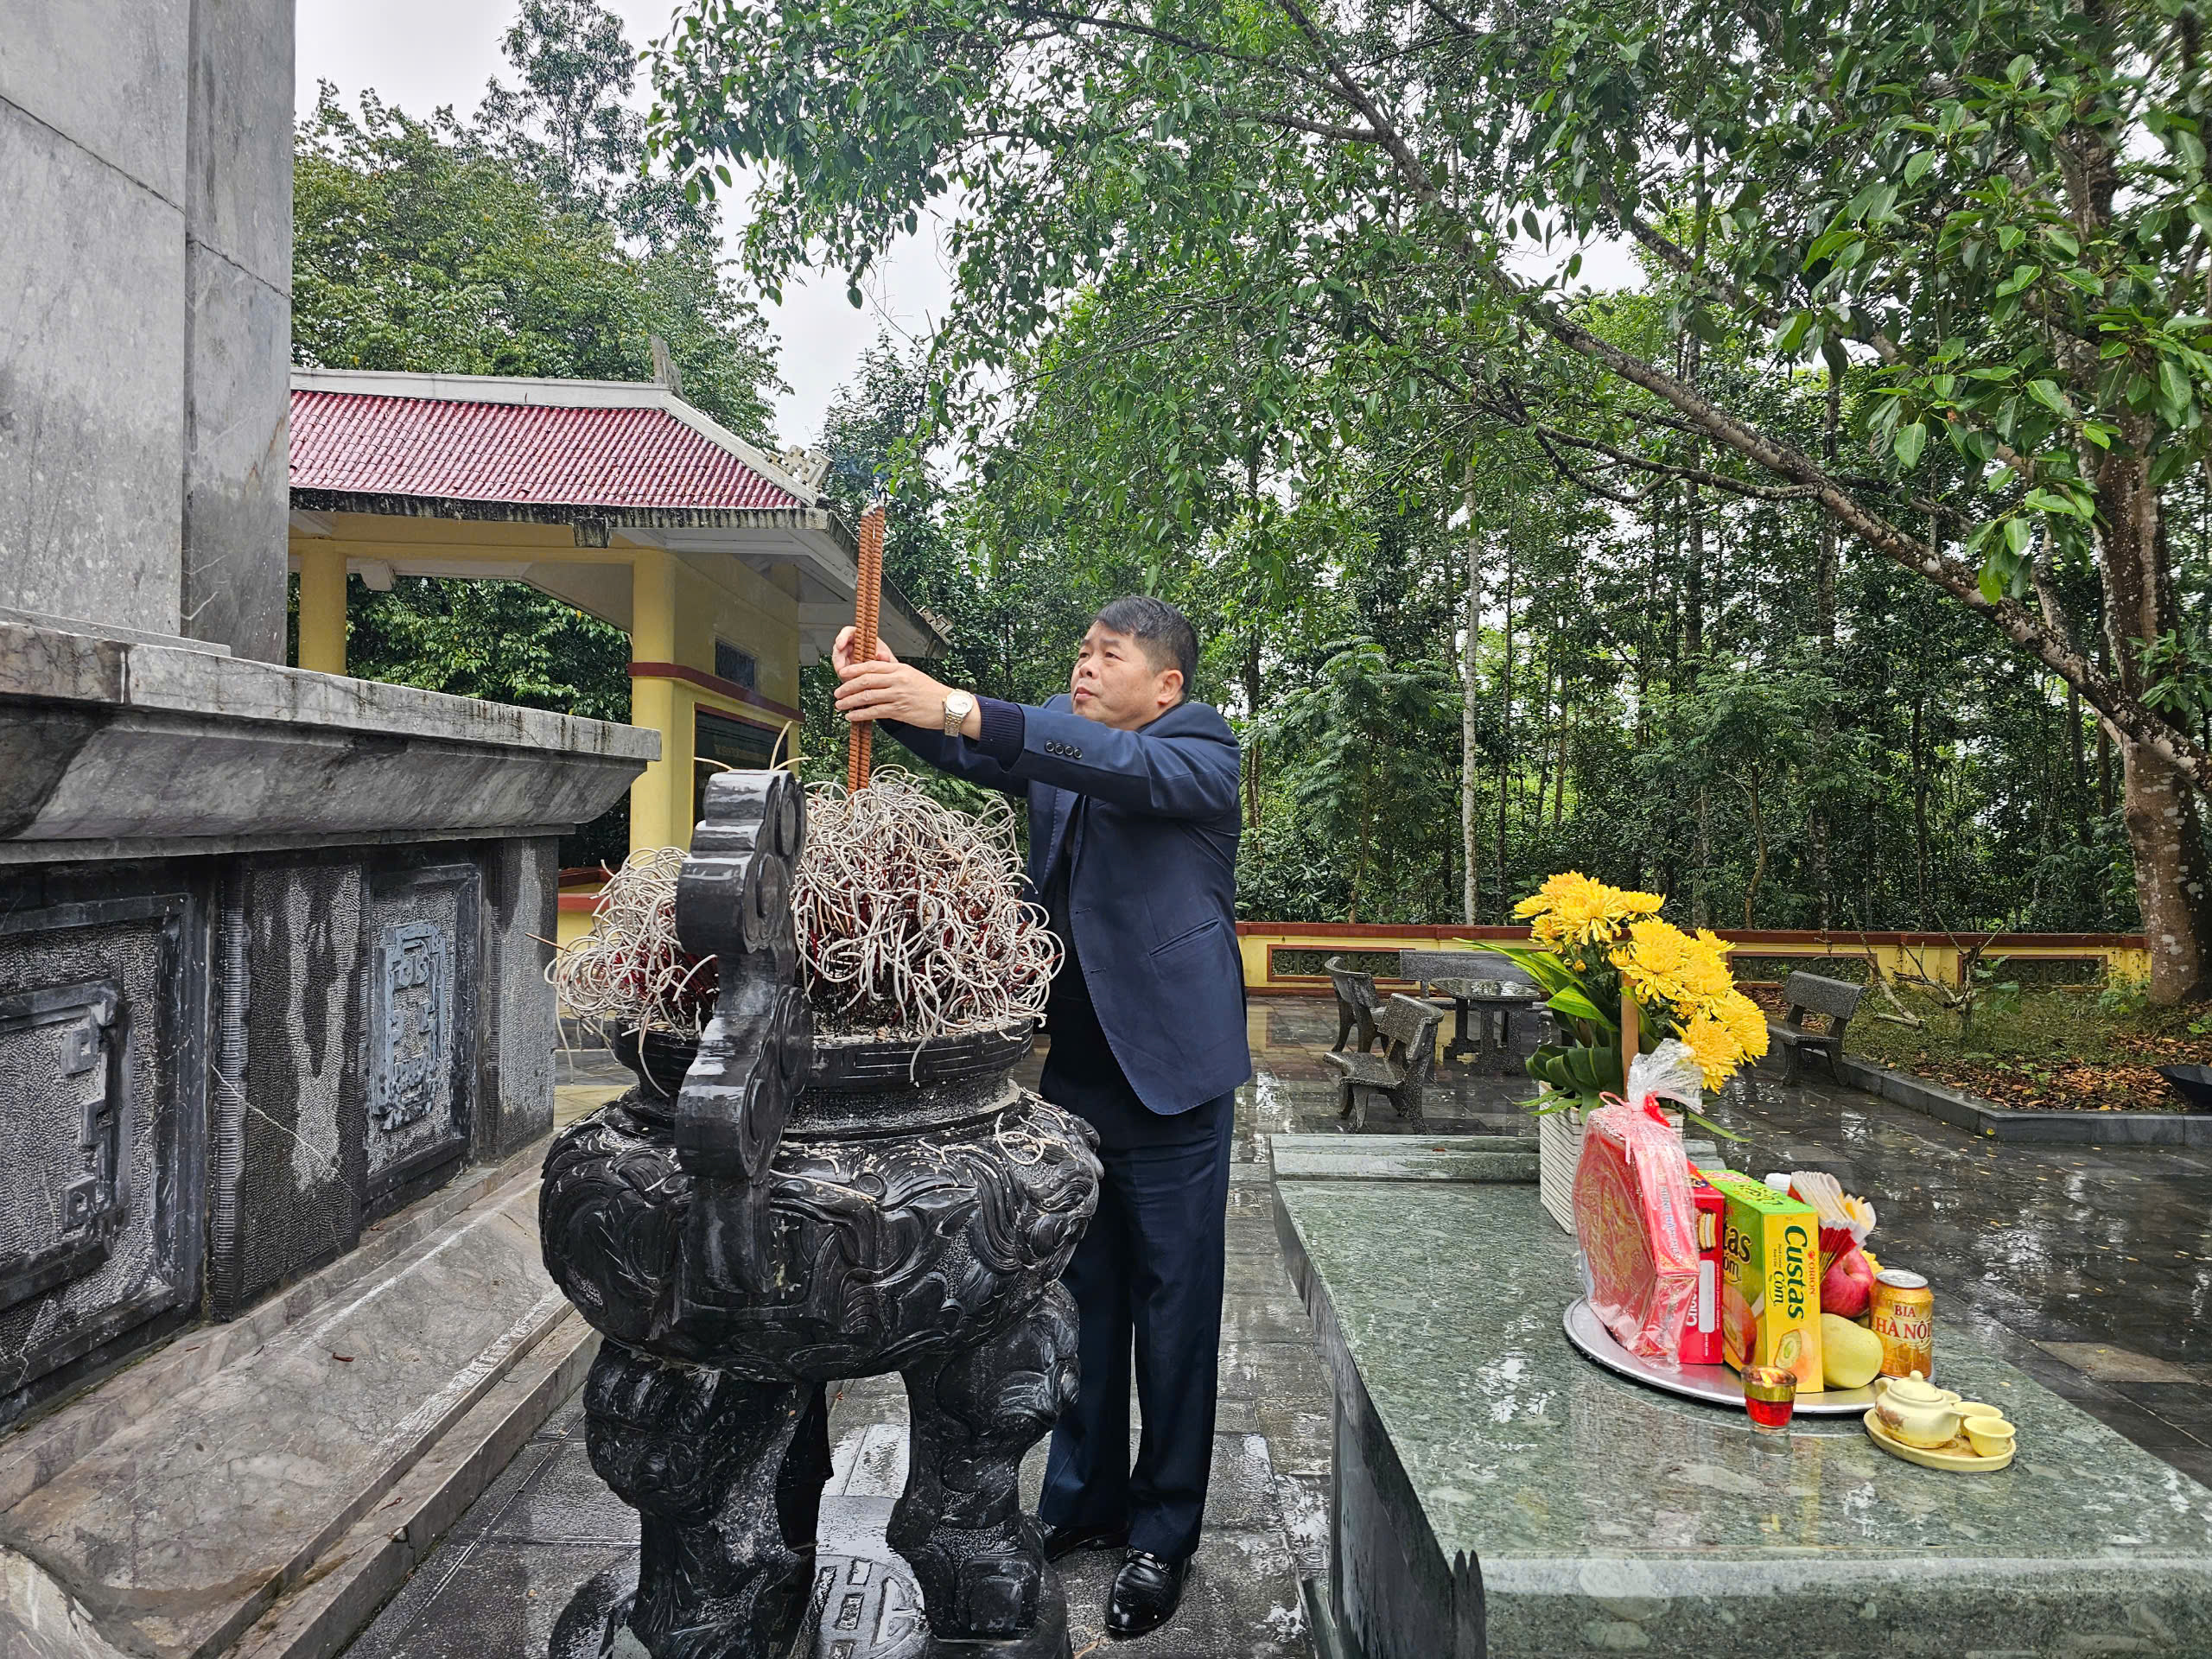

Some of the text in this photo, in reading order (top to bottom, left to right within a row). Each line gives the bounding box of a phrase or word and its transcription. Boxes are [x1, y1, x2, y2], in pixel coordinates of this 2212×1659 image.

[1784, 1225, 1808, 1319] Custas
[1894, 1305, 1916, 1318] BIA
[1875, 1316, 1930, 1343] HÀ NỘI
